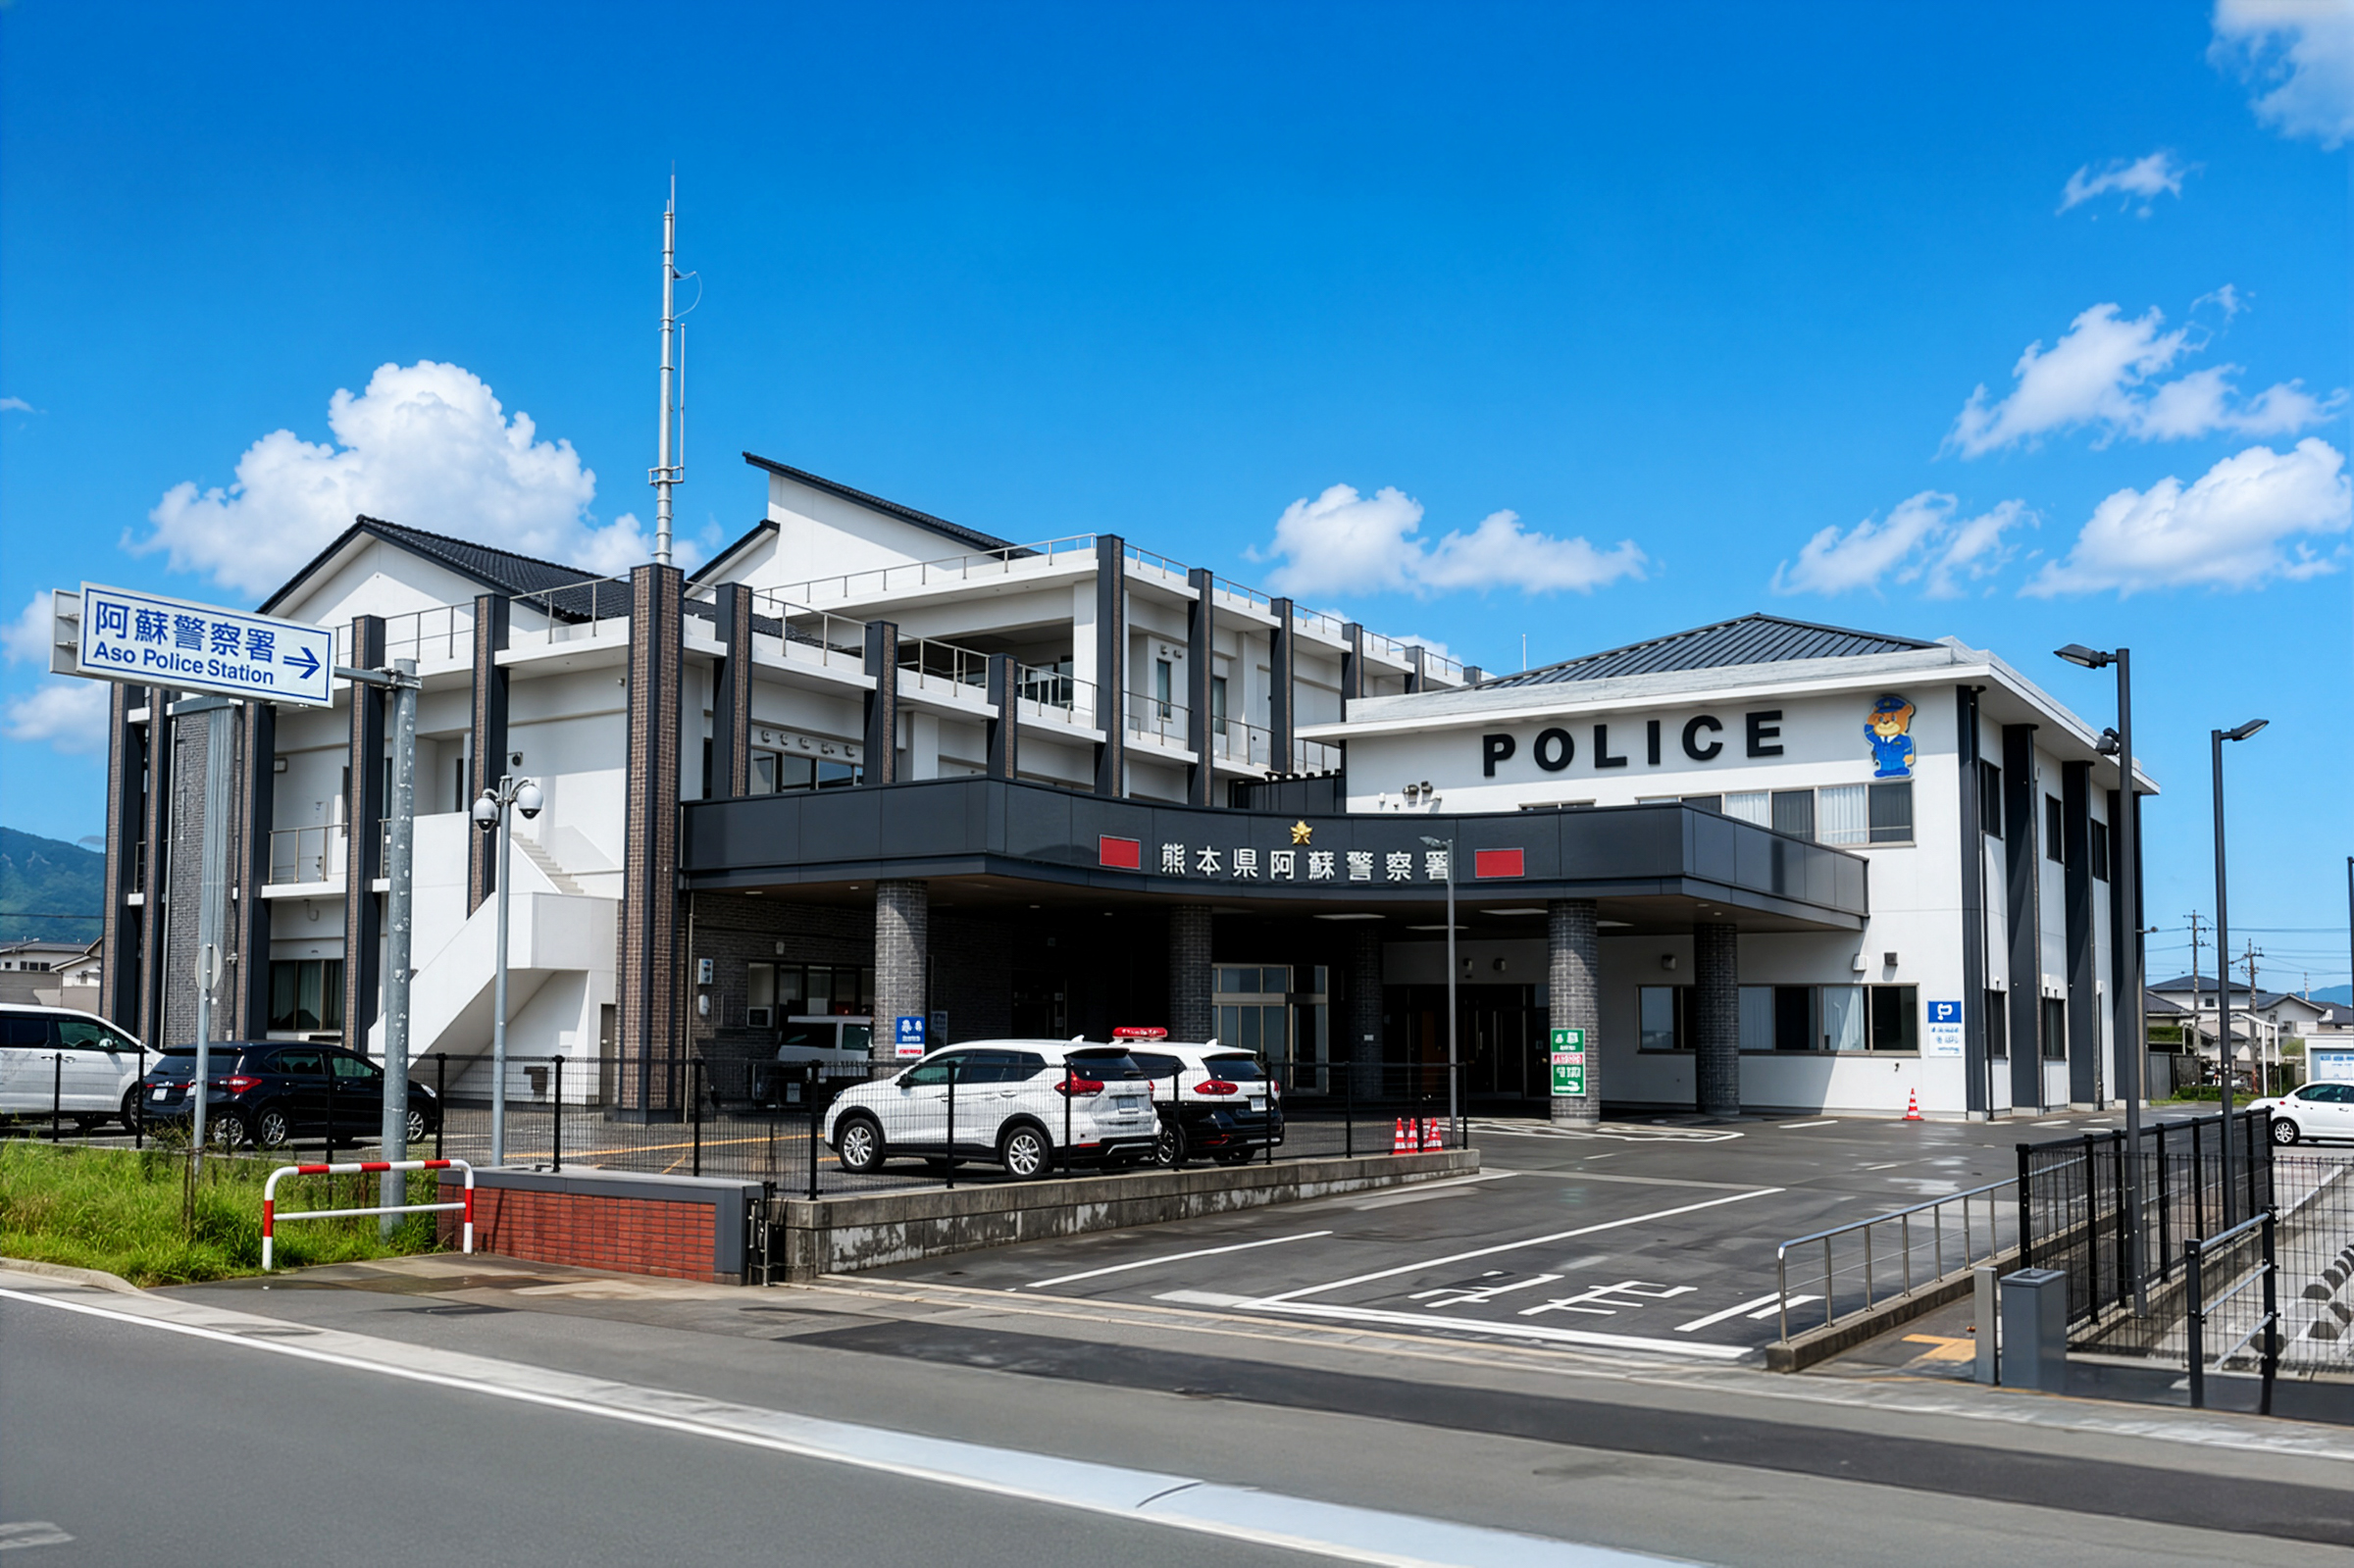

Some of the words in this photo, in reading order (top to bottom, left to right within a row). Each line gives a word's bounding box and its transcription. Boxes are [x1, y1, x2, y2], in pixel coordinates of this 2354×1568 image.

[95, 600, 275, 663] 阿蘇警察署
[93, 640, 135, 664] Aso
[143, 648, 204, 675] Police
[207, 659, 274, 684] Station
[1482, 709, 1784, 778] POLICE
[1161, 842, 1449, 882] 熊本県阿蘇警察署
